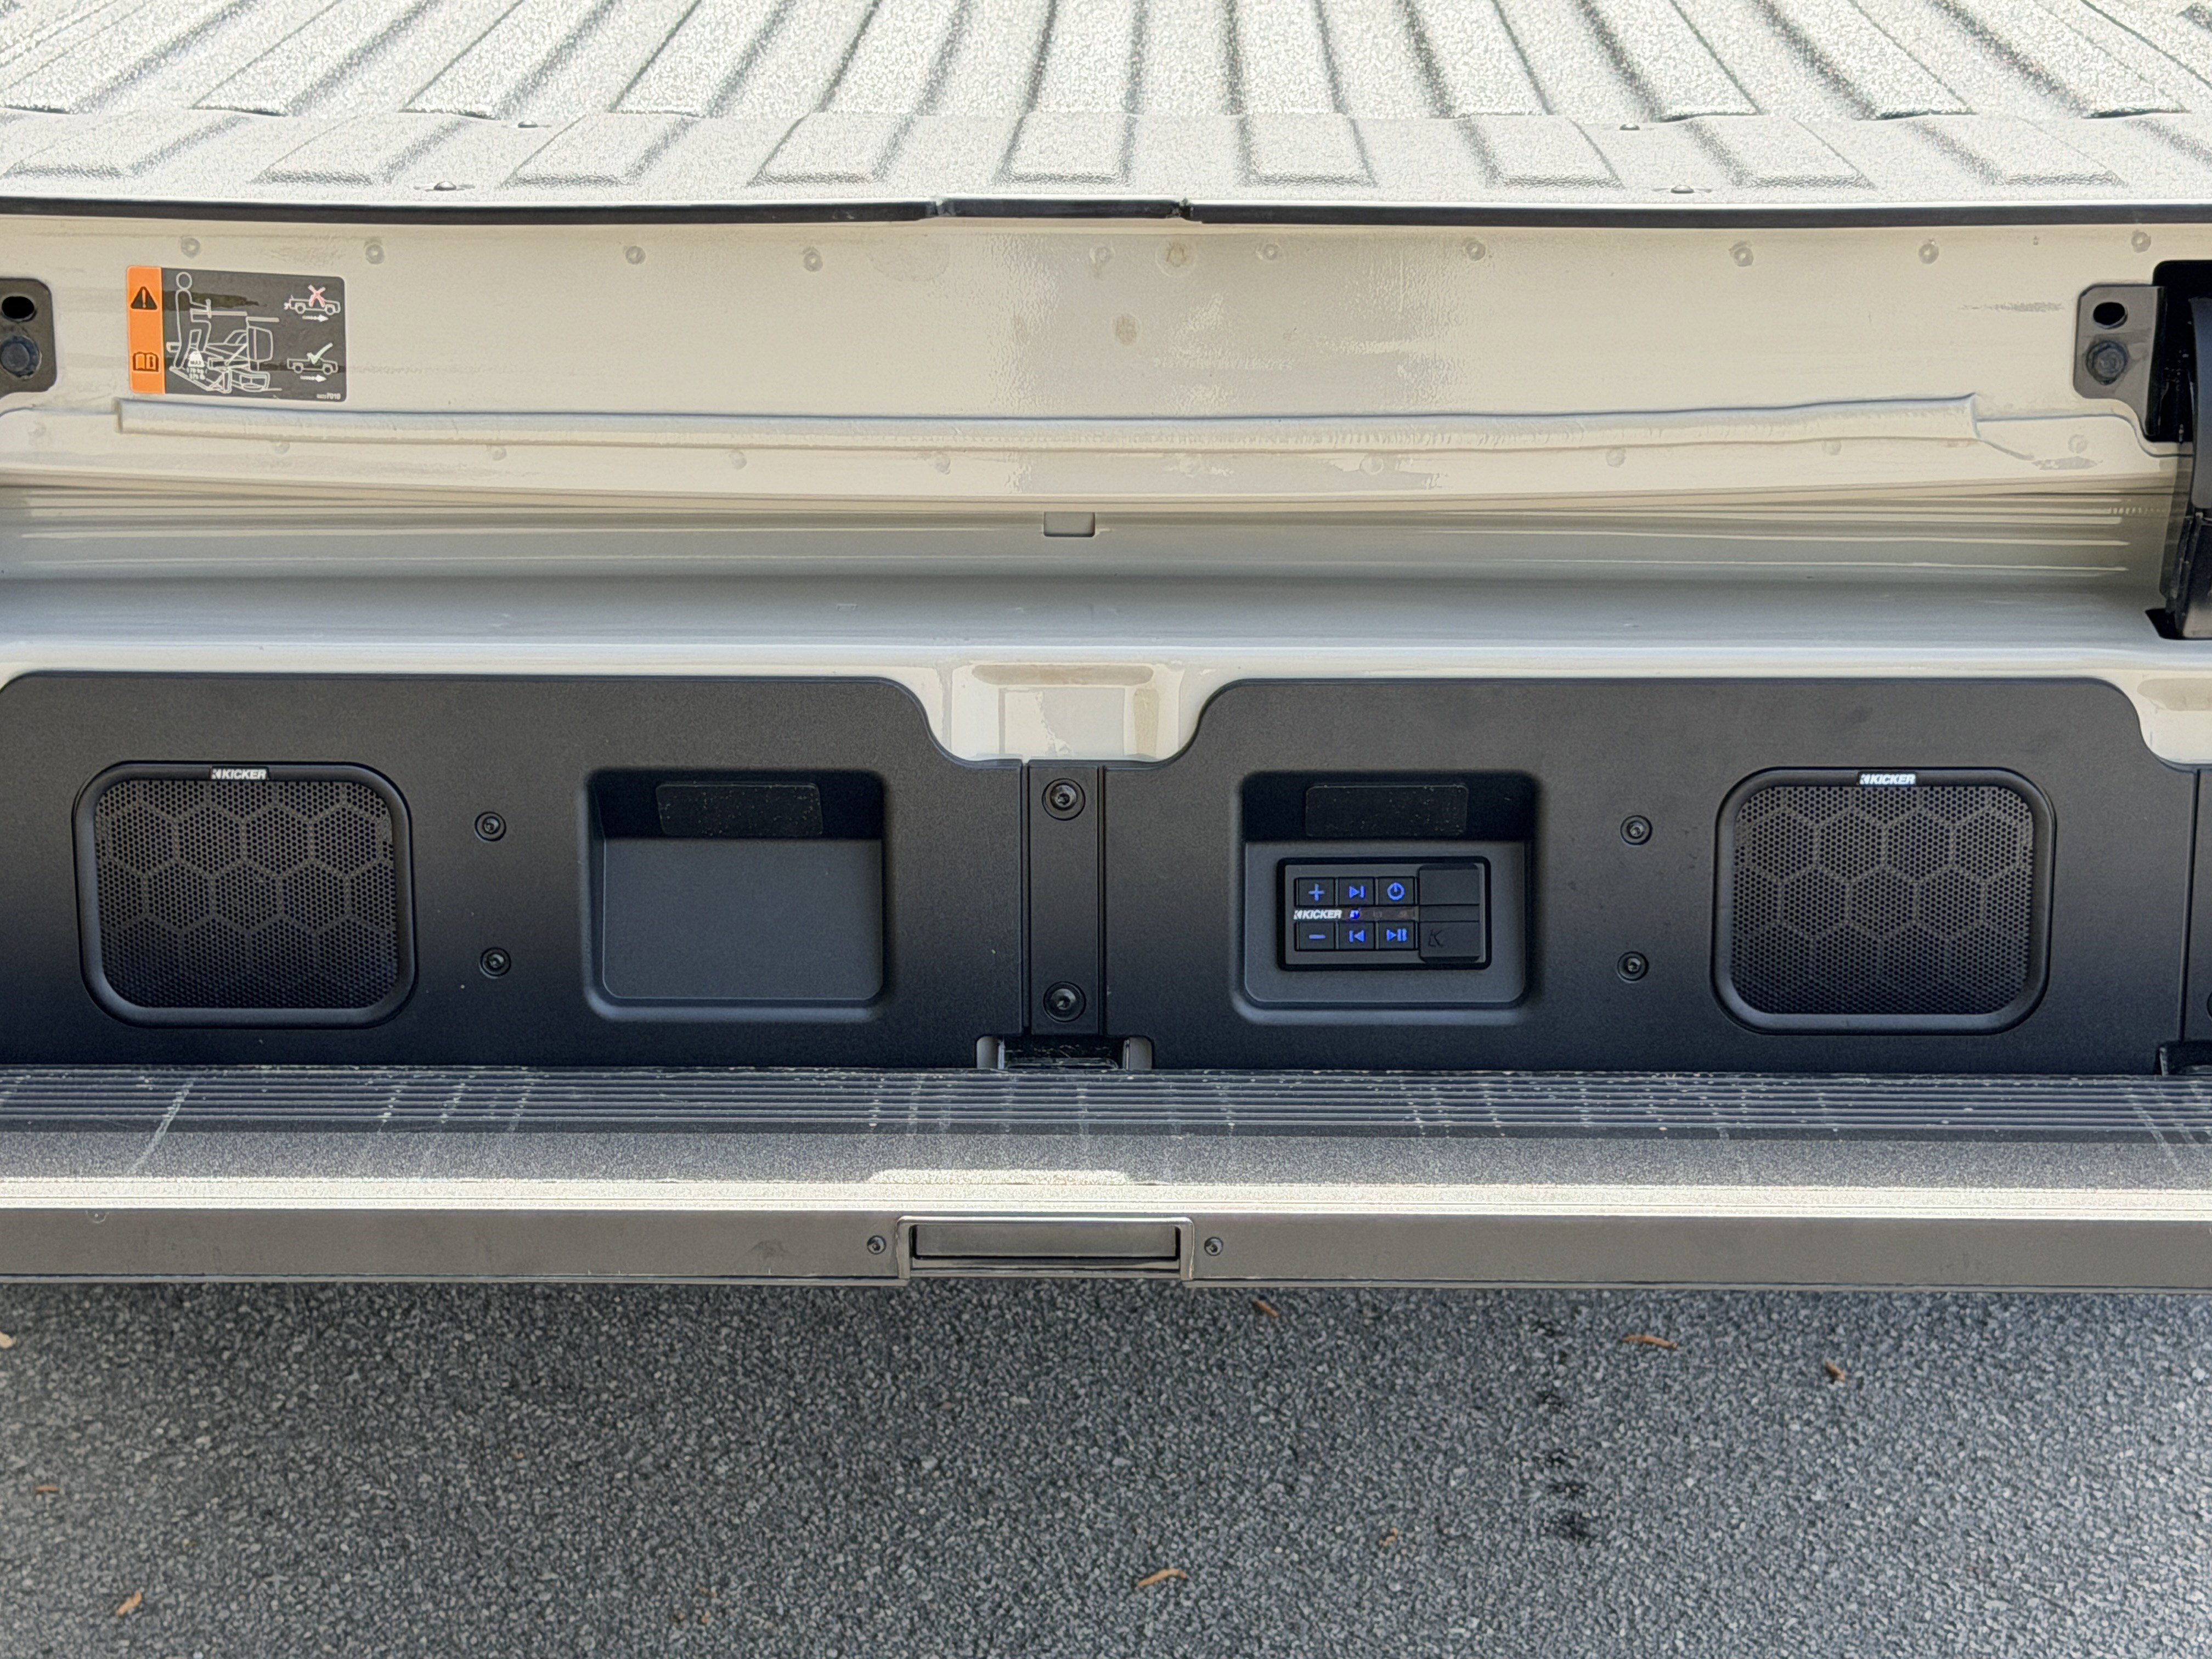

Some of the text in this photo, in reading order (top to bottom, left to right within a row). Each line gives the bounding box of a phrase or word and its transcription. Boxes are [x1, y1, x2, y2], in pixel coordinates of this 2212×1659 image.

[222, 769, 267, 780] KICKER
[1870, 774, 1916, 785] KICKER
[1302, 909, 1342, 919] KICKER
